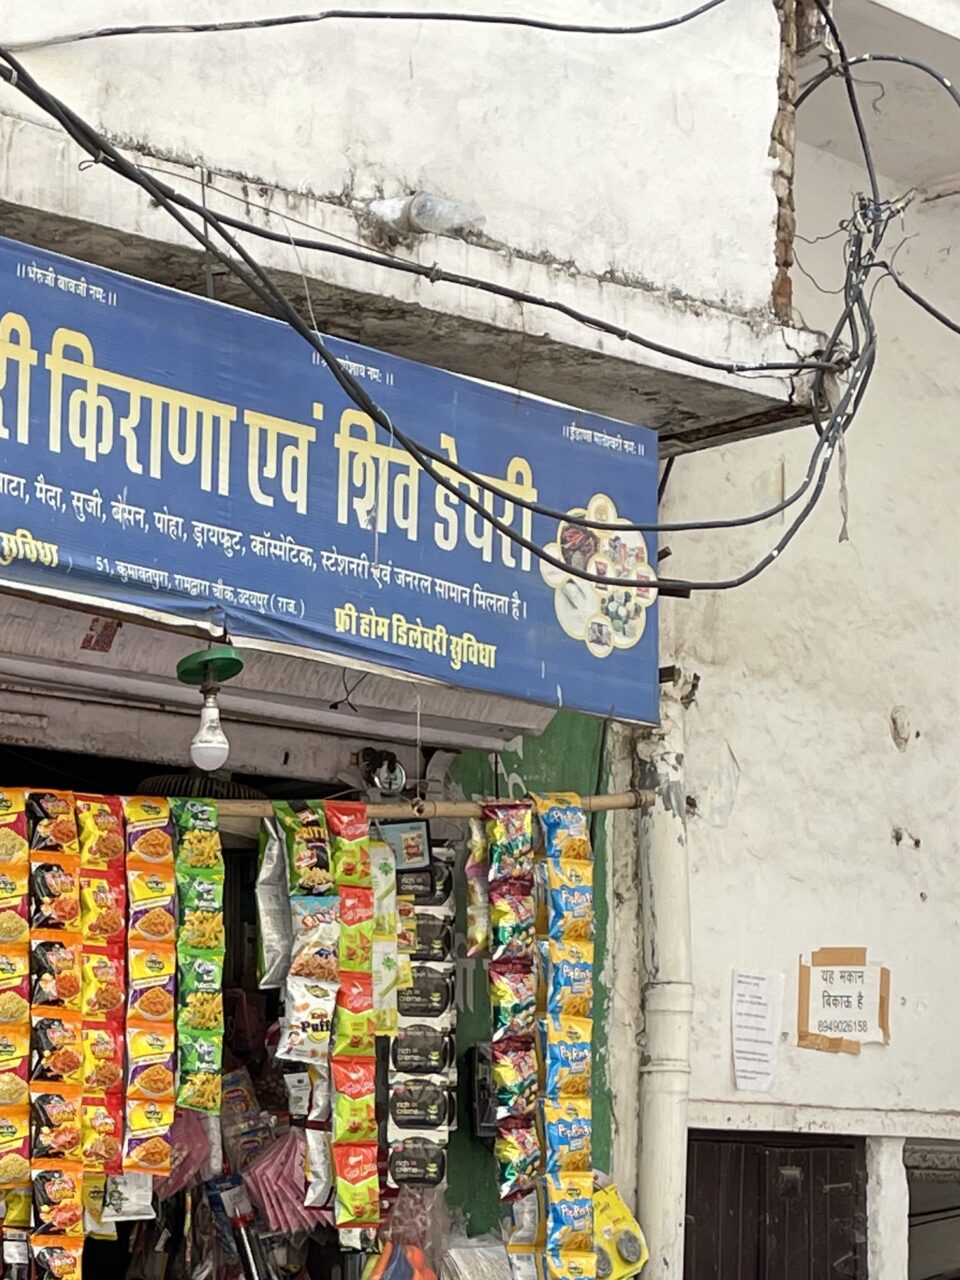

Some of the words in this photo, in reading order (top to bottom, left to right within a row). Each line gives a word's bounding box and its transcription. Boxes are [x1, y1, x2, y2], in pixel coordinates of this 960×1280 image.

[45, 327, 237, 496] किराणा
[243, 402, 324, 515] एवं
[334, 408, 425, 542] शिव
[431, 432, 538, 572] डेयरी
[34, 474, 67, 513] मैदा,
[70, 489, 107, 523] सुजी,
[153, 506, 188, 541] पोहा,
[321, 546, 370, 579] स्टेशनरी
[394, 568, 432, 594] जनरल
[434, 578, 470, 606] सामान
[472, 583, 509, 614] मिलता
[359, 607, 390, 642] होम
[392, 613, 448, 656] डिलेवरी
[450, 633, 497, 670] सुविधा
[821, 970, 835, 985] यह
[839, 970, 865, 985] मकान
[822, 991, 853, 1010] बिकाऊ
[857, 992, 864, 1010] है
[818, 1020, 868, 1033] 8949026158
